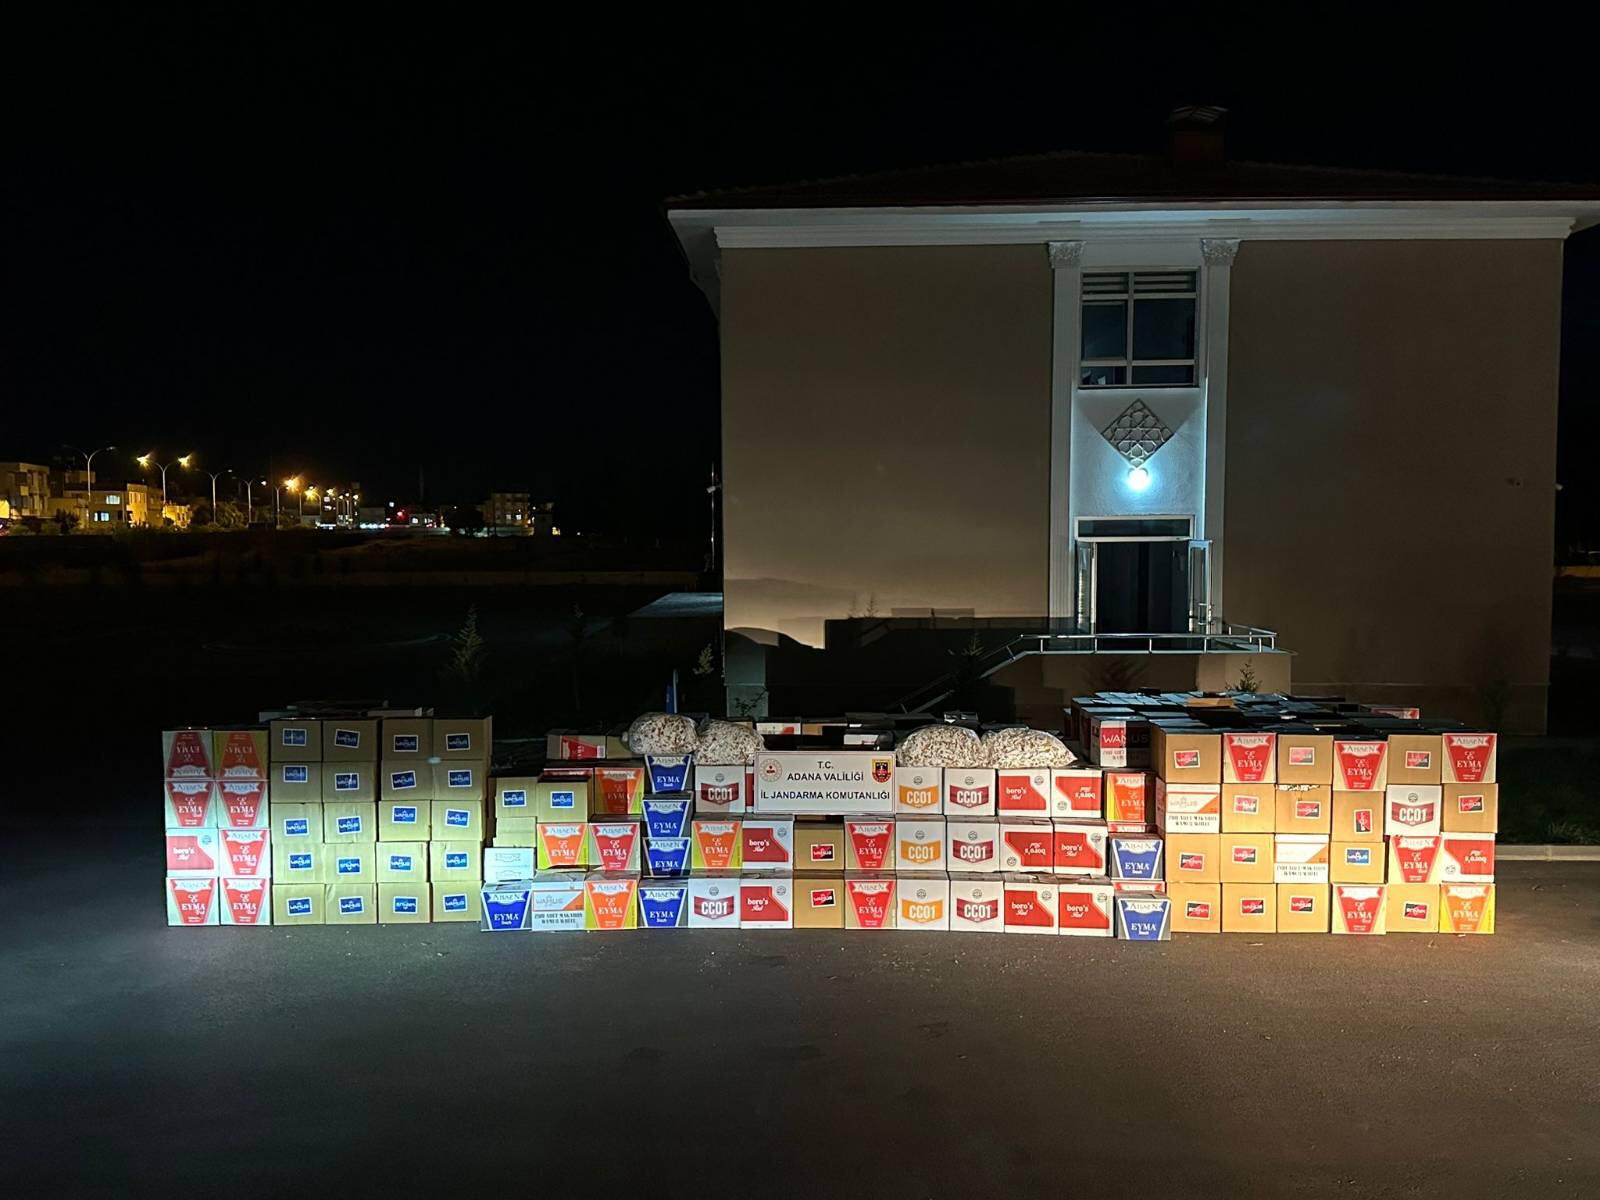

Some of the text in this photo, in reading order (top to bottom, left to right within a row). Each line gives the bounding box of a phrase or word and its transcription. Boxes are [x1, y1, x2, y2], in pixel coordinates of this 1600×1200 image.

[817, 761, 834, 769] T.C.
[1238, 760, 1262, 768] EYMA
[1348, 768, 1372, 776] EYMA
[787, 773, 821, 781] ADANA
[824, 772, 864, 781] VALİLİĞİ
[760, 790, 890, 800] İL JANDARMA KOMUTANLIĞI
[179, 805, 203, 813] EYMA
[230, 805, 254, 813] EYMA
[749, 839, 770, 847] boro's
[552, 849, 575, 857] EYMA
[1125, 862, 1150, 870] EYMA
[182, 903, 206, 911] EYMA
[494, 913, 519, 921] EYMA
[1348, 911, 1372, 919] EYMA
[1131, 923, 1157, 931] EYMA
